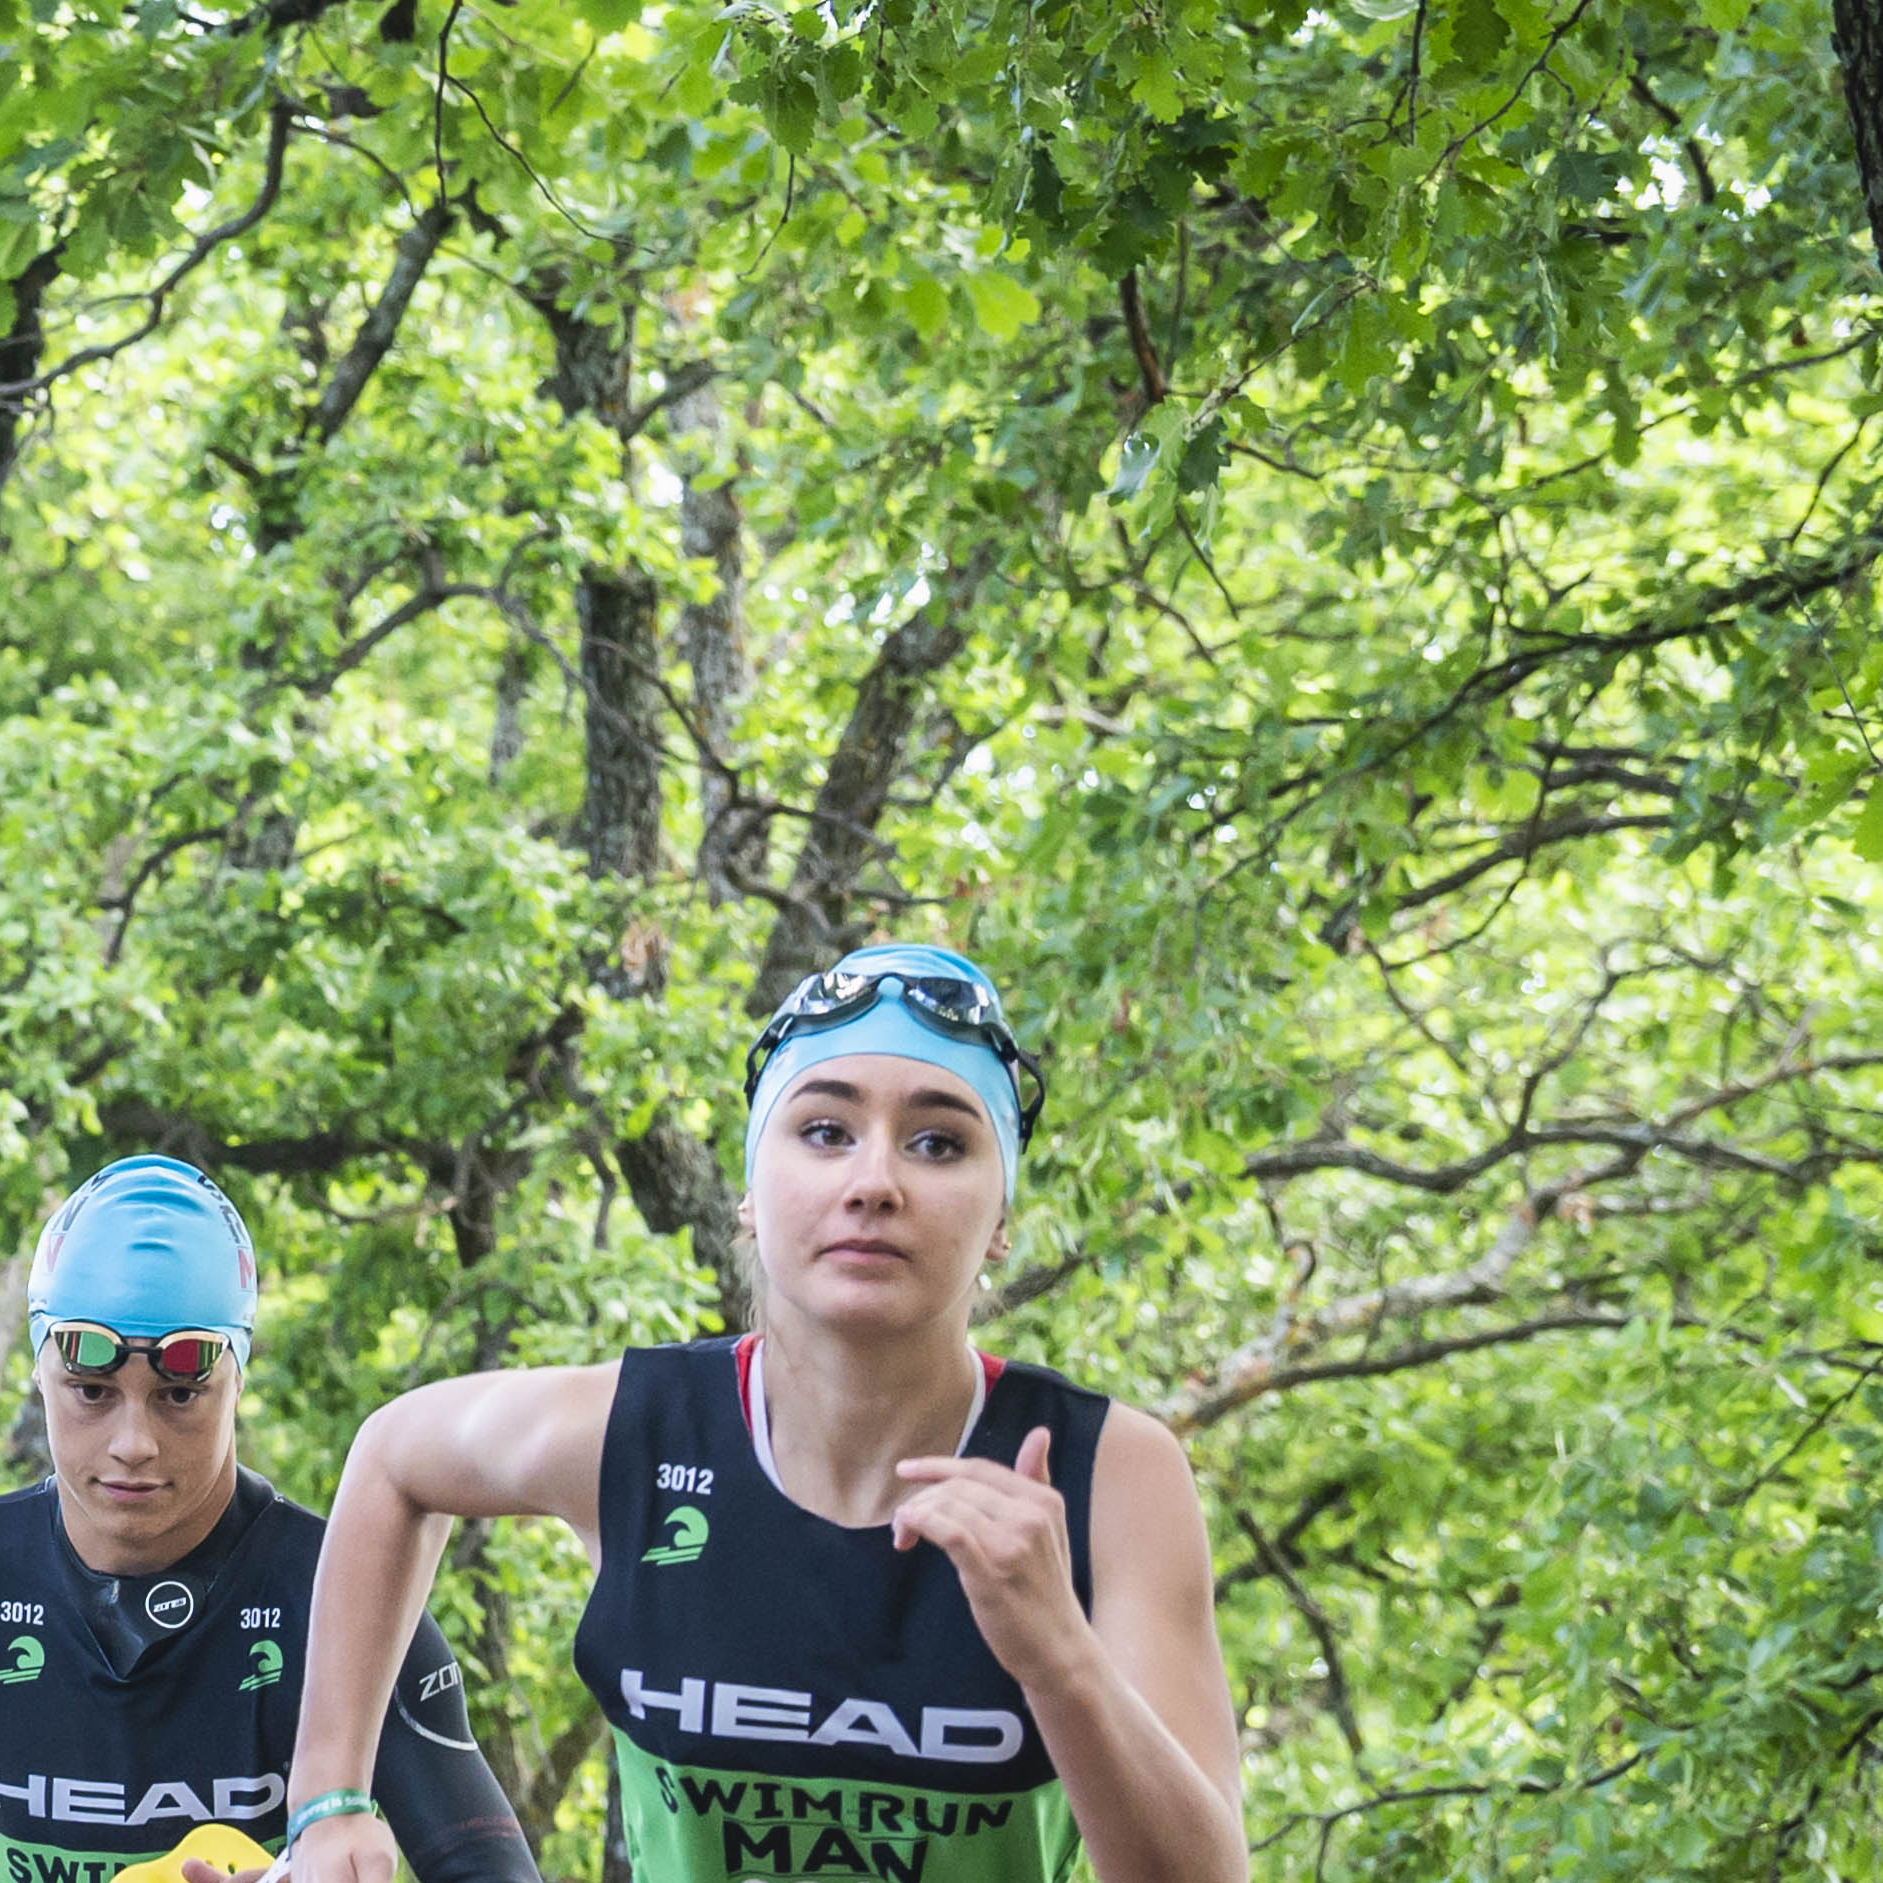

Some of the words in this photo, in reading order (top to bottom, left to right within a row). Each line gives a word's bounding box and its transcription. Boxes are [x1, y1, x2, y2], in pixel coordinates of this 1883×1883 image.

[657, 1463, 714, 1495] 3012
[0, 1601, 44, 1626] 3012
[240, 1608, 282, 1629] 3012
[620, 1668, 1024, 1765] HEAD
[655, 1767, 1014, 1838] SWIMRUN
